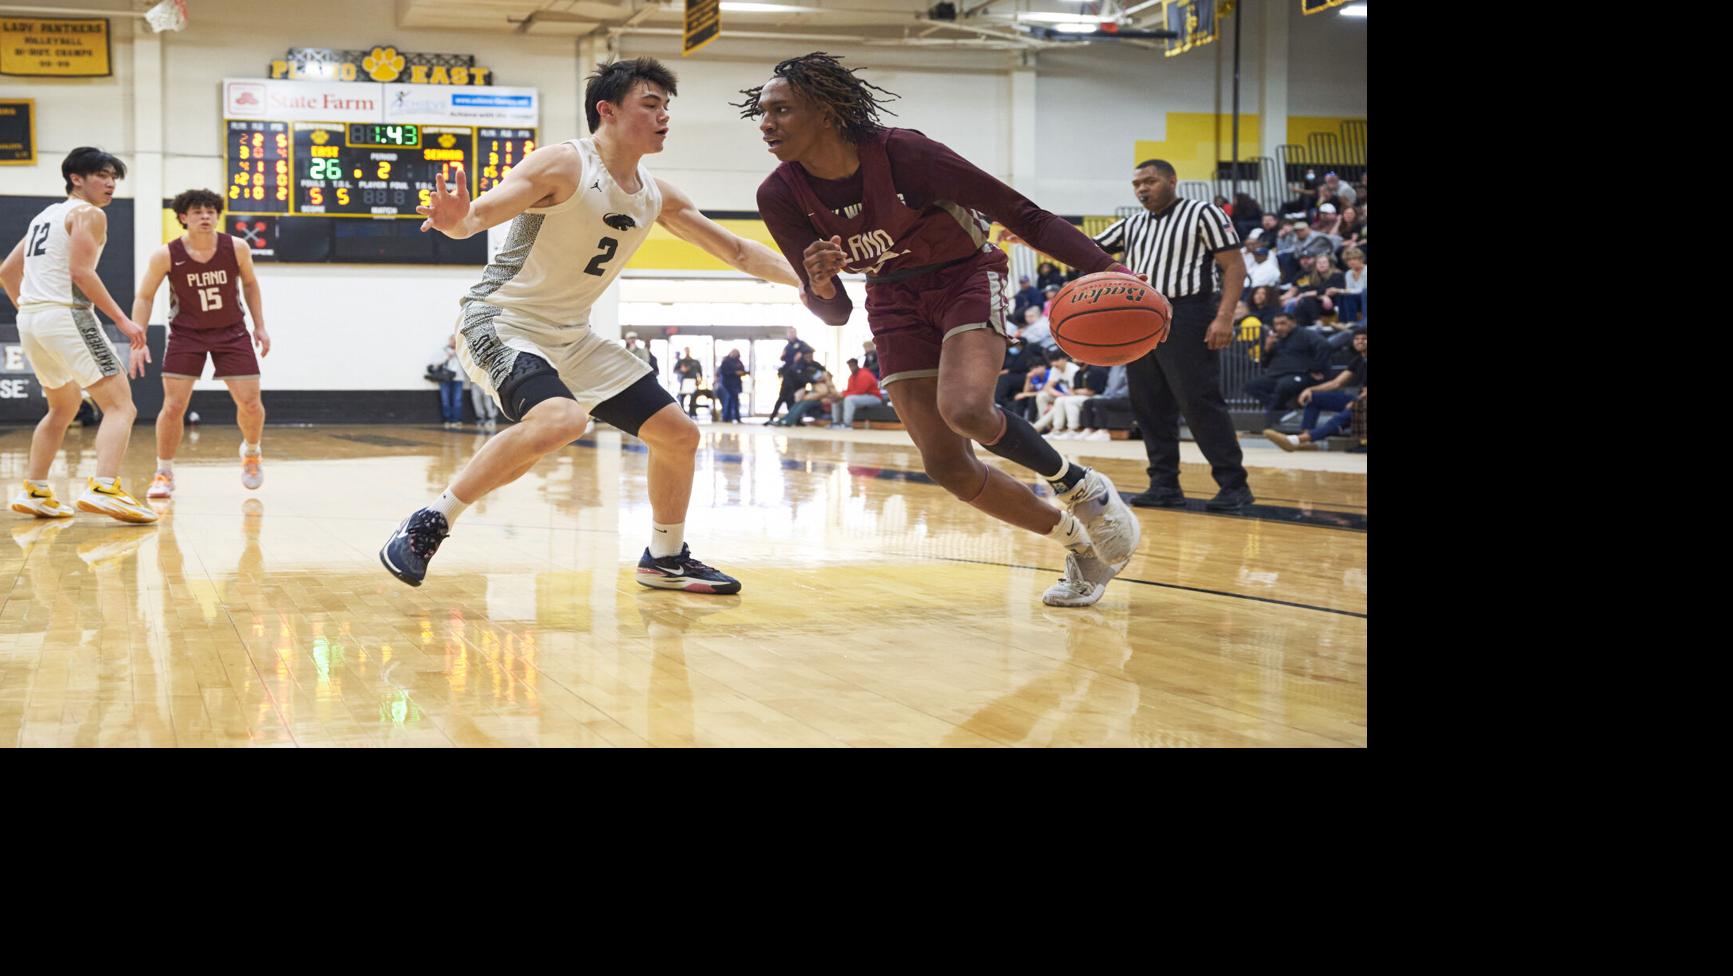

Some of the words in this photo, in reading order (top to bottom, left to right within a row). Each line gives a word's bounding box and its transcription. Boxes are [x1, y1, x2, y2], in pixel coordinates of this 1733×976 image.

[2, 22, 34, 33] LADY
[40, 22, 102, 33] PANTHERS
[23, 36, 83, 46] VOLLEYBALL
[55, 48, 94, 57] CHAMPS
[410, 65, 490, 86] EAST
[269, 93, 318, 110] State
[322, 93, 375, 112] Farm
[310, 145, 340, 158] EAST
[370, 152, 398, 162] PERIOD
[309, 157, 342, 180] 26
[377, 161, 392, 180] 2
[358, 180, 387, 190] PLAYER
[389, 181, 410, 190] FOUL
[309, 187, 324, 205] 5
[336, 188, 351, 206] 5
[25, 222, 51, 258] 12
[583, 236, 619, 277] 2
[186, 269, 228, 287] PLANO
[197, 287, 223, 312] 15
[1071, 286, 1146, 304] Baden
[81, 327, 117, 373] PANTHERS
